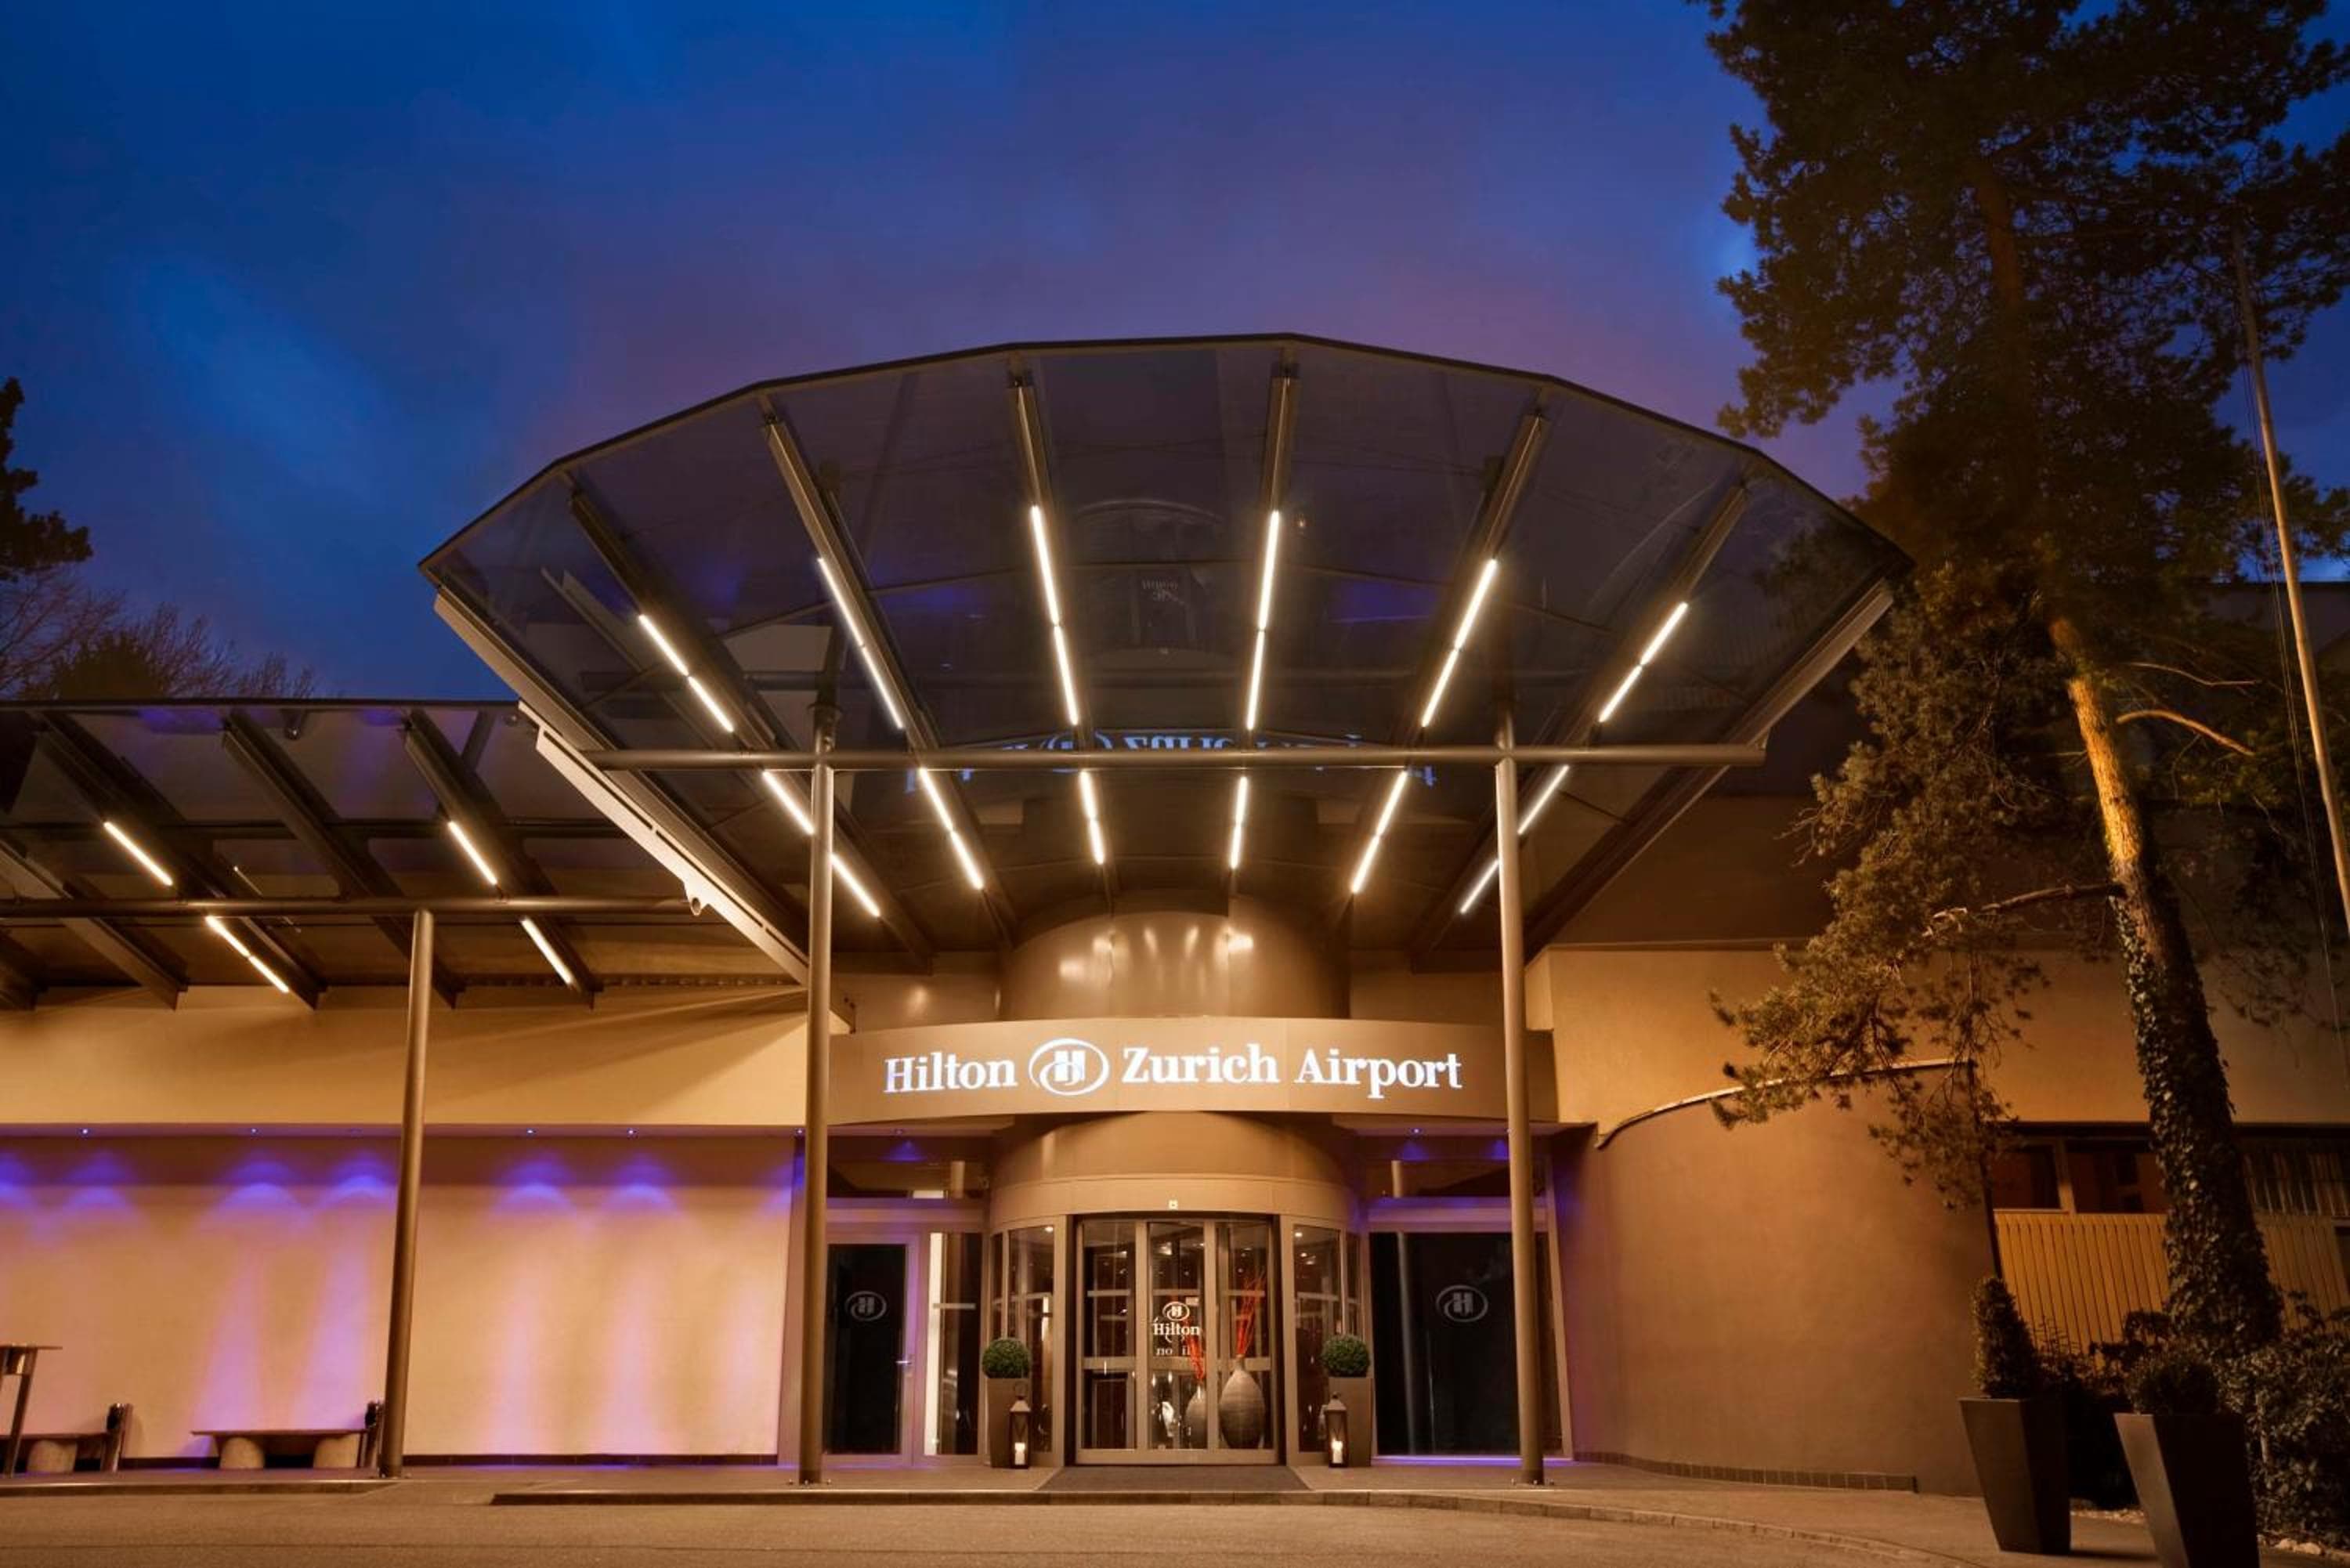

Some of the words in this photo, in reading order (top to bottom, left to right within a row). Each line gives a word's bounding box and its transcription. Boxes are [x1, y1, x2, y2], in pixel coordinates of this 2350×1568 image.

[883, 1052, 1018, 1093] Hilton
[1121, 1043, 1280, 1084] Zurich
[1293, 1048, 1462, 1099] Airport
[1153, 1321, 1200, 1335] Hilton
